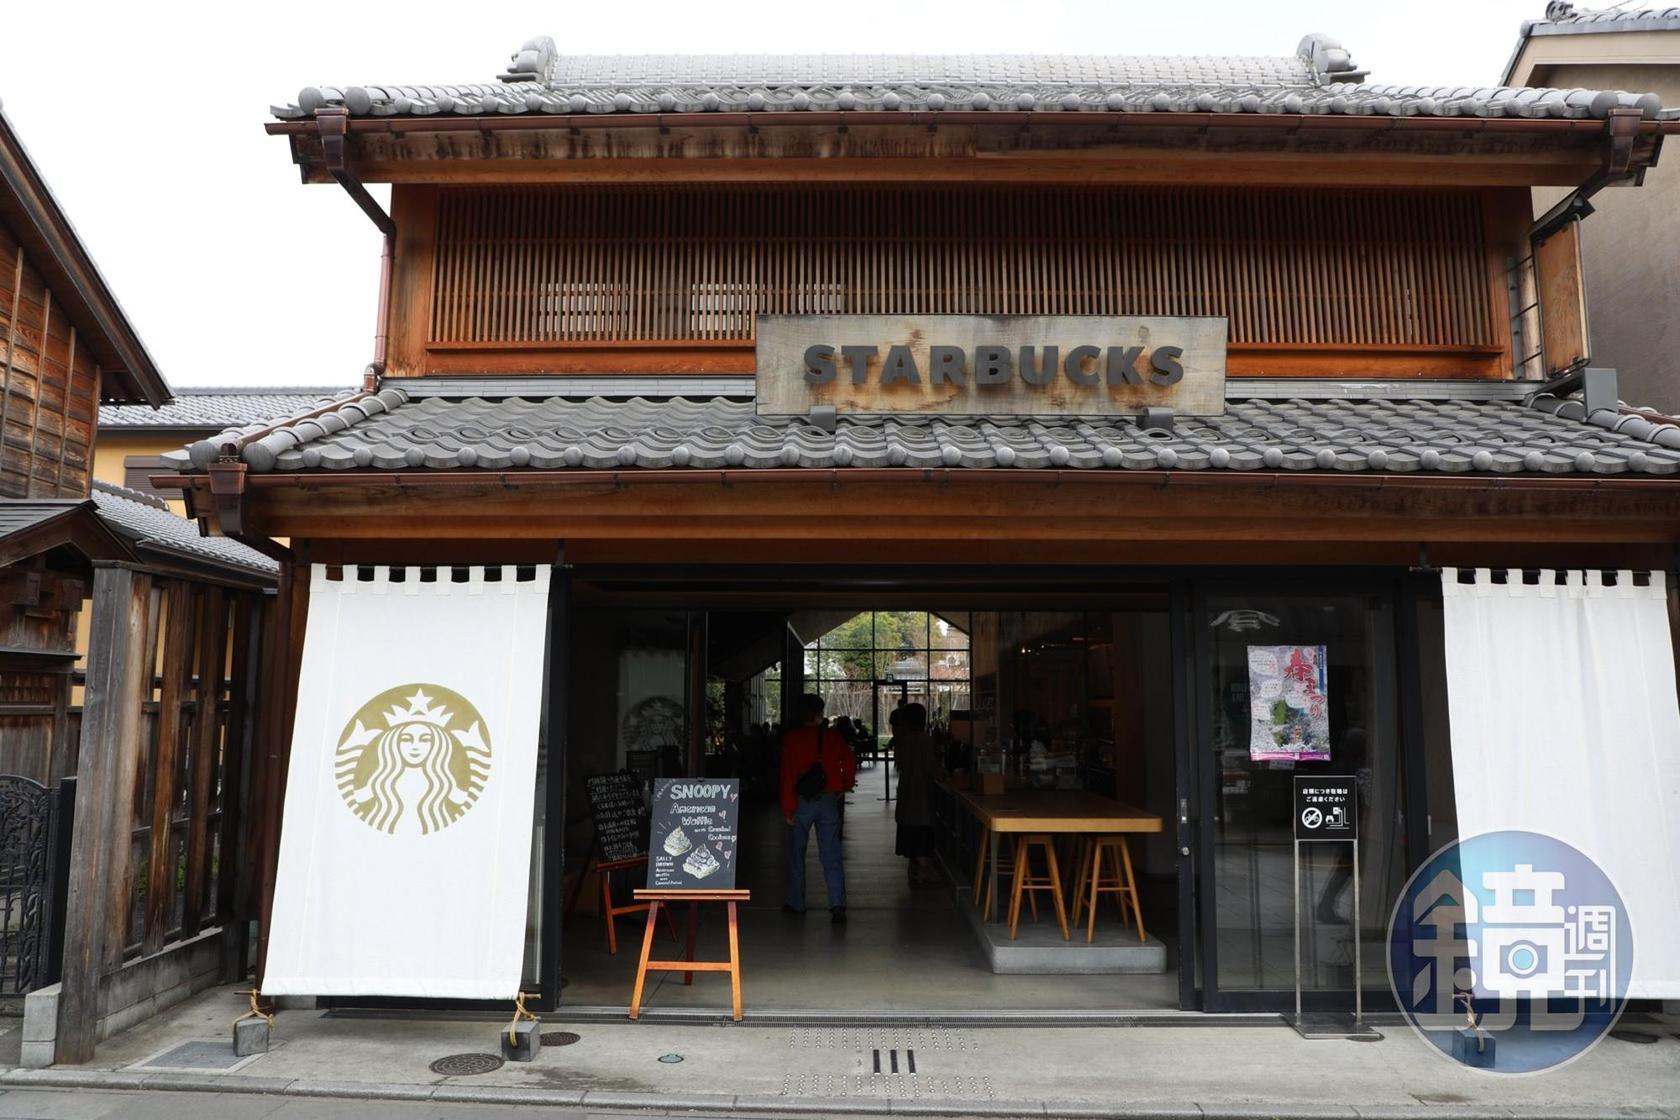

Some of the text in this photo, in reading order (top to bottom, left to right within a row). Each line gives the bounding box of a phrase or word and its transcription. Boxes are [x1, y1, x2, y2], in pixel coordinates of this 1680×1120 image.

[803, 344, 1185, 387] STARBUCKS
[670, 784, 732, 800] SNOOPY
[669, 802, 716, 815] American
[681, 816, 713, 826] Waffle
